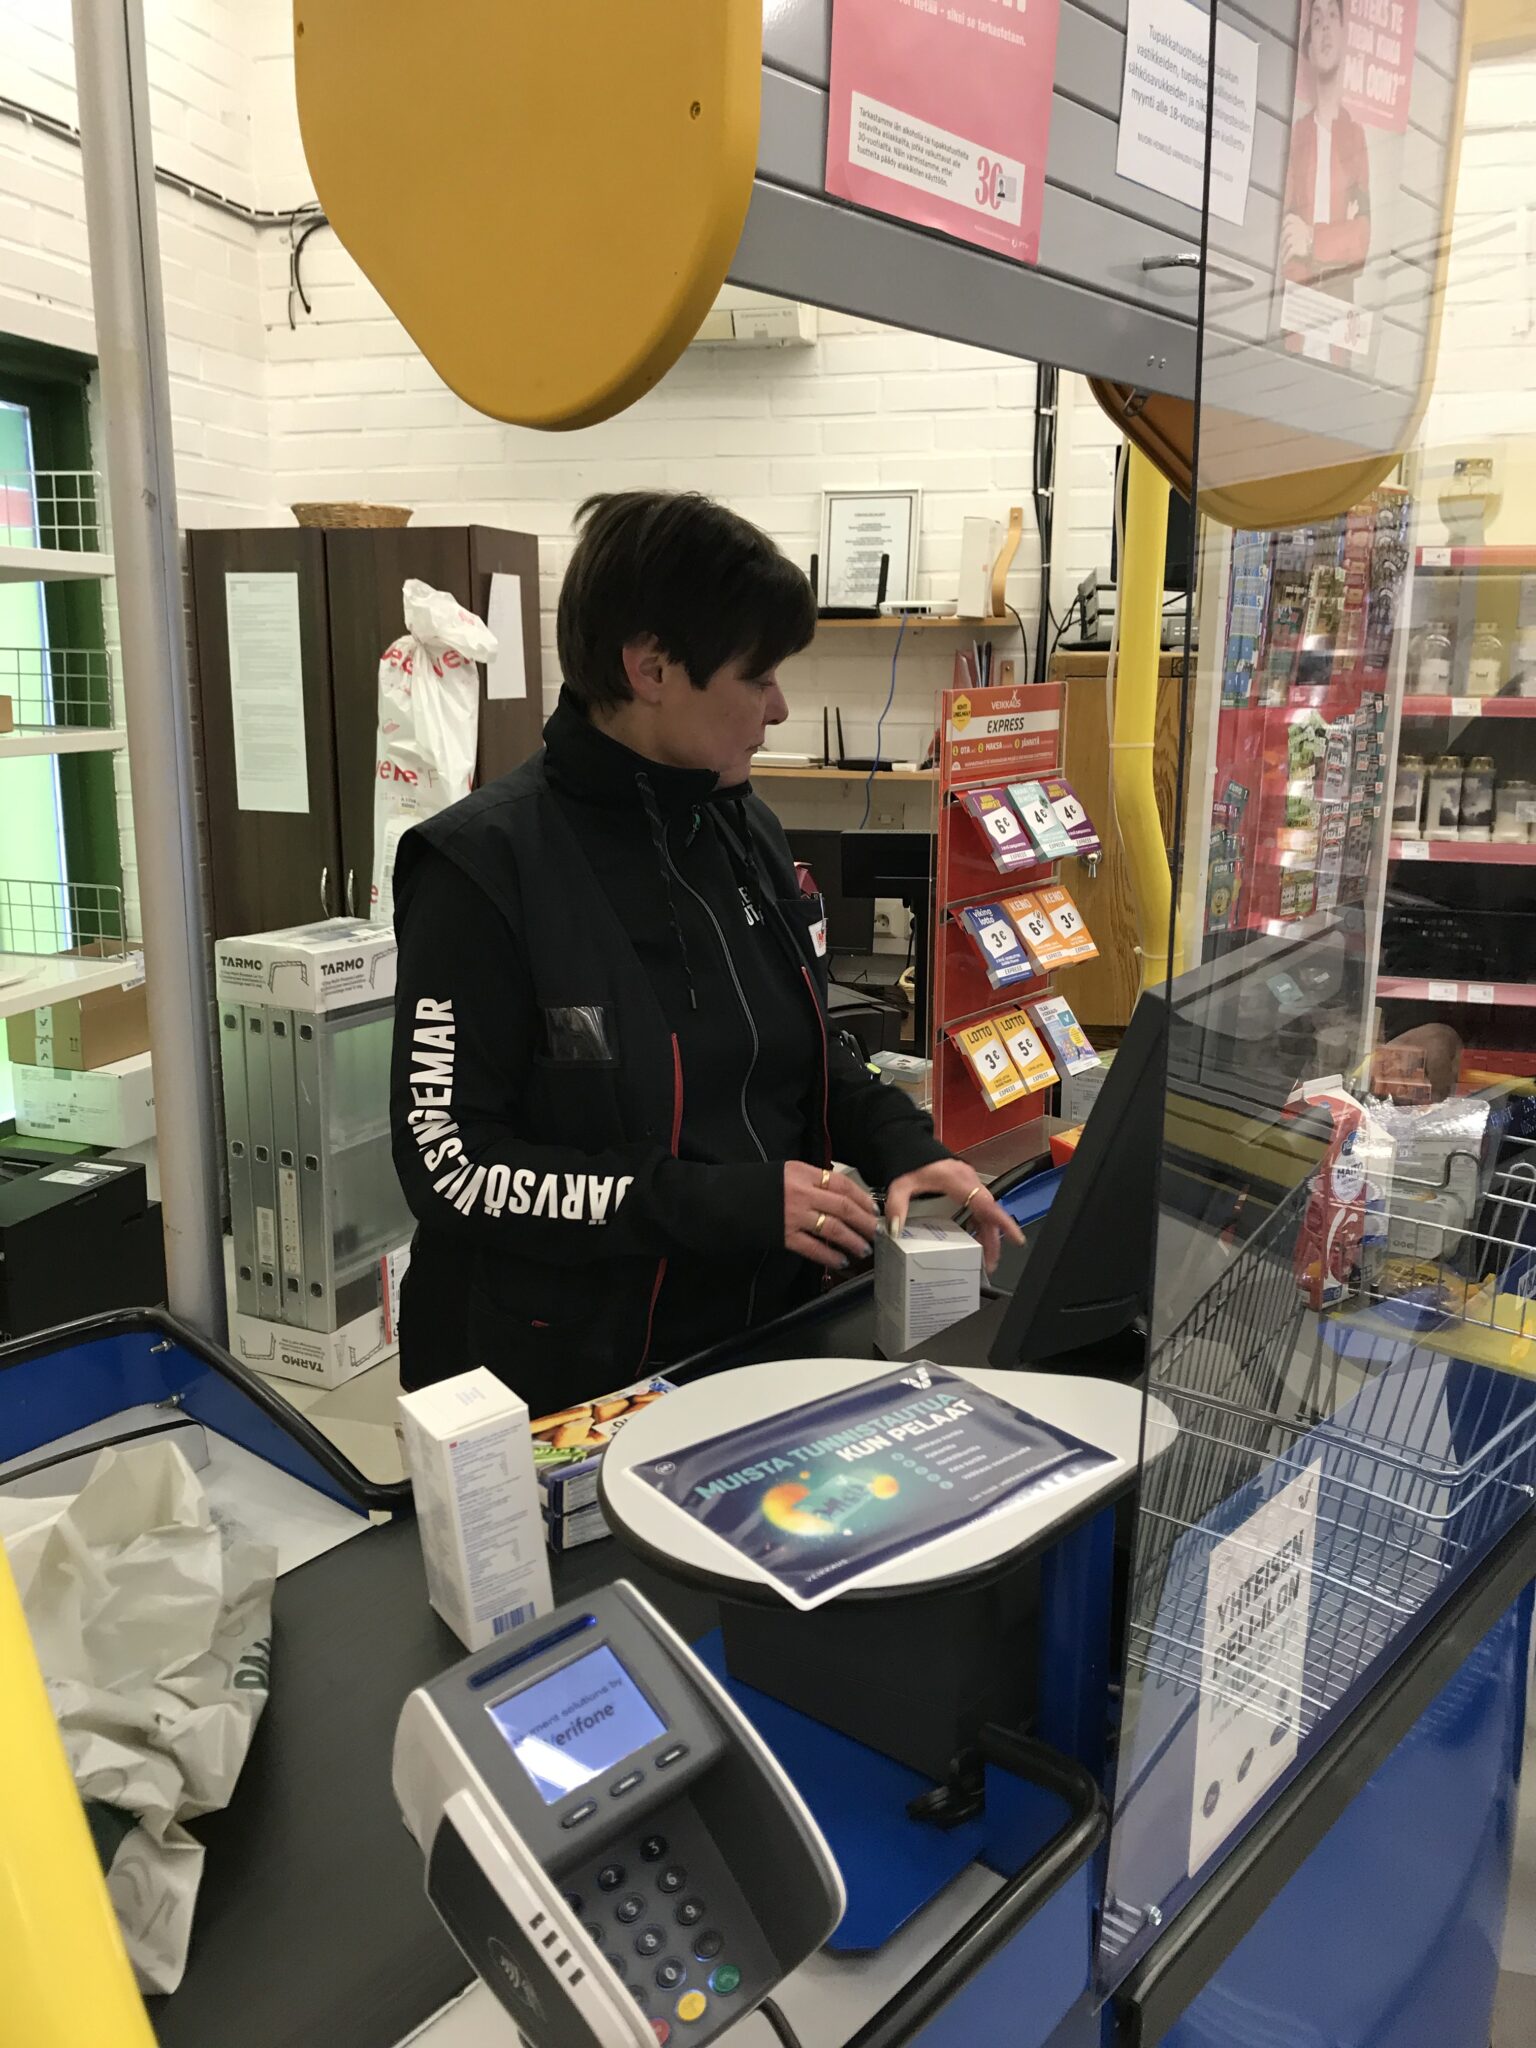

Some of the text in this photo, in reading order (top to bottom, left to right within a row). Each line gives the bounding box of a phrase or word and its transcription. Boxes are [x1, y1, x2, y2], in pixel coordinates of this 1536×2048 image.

[947, 8, 965, 25] siksi
[967, 17, 976, 28] se
[978, 19, 1026, 46] tarkastetaan.
[1131, 88, 1155, 108] myynti
[1156, 97, 1168, 115] alle
[1188, 95, 1194, 108] ja
[860, 107, 893, 128] Tarkastamme
[987, 717, 1024, 733] EXPRESS
[973, 908, 993, 918] viking
[978, 917, 995, 926] lotto
[220, 956, 263, 971] TARMO
[321, 958, 364, 976] TARMO
[1000, 1015, 1025, 1031] LOTTO
[967, 1026, 992, 1044] LOTTO
[282, 1354, 325, 1373] TARMO
[835, 1399, 975, 1462] KUN PELAAT
[695, 1391, 959, 1501] MUISTA TUNNISTAUTUA
[805, 1558, 848, 1582] VEIKKAUS
[1217, 1530, 1304, 1632] YHTEISEN
[1213, 1570, 1300, 1680] PELI-ILON
[609, 1677, 622, 1689] by
[648, 1841, 659, 1854] 3
[606, 1870, 616, 1882] 2
[667, 1872, 677, 1885] 6
[626, 1902, 636, 1915] 5
[686, 1905, 696, 1918] 9
[646, 1934, 657, 1947] 8
[665, 1967, 676, 1980] 0
